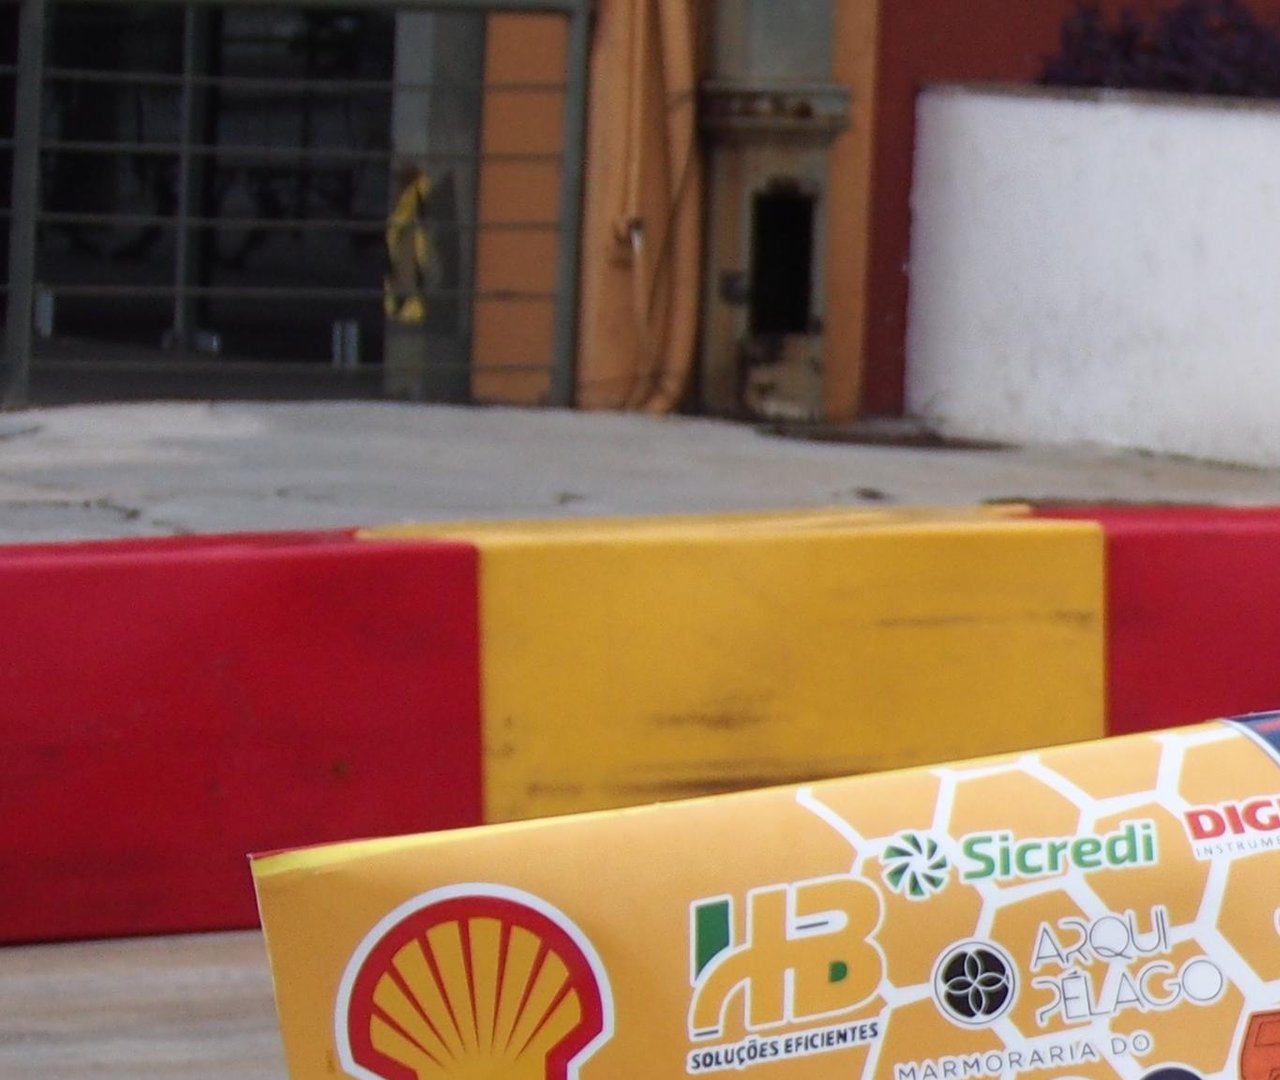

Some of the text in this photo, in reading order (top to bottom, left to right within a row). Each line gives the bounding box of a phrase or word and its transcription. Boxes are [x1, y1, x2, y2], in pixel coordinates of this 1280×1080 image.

[963, 822, 1155, 880] Sicredi
[1033, 909, 1169, 969] ARQUI
[1034, 959, 1224, 1023] PÉLAGO
[691, 1022, 879, 1070] SOLUÇÕES EFICIENTES
[1110, 1033, 1151, 1057] DO
